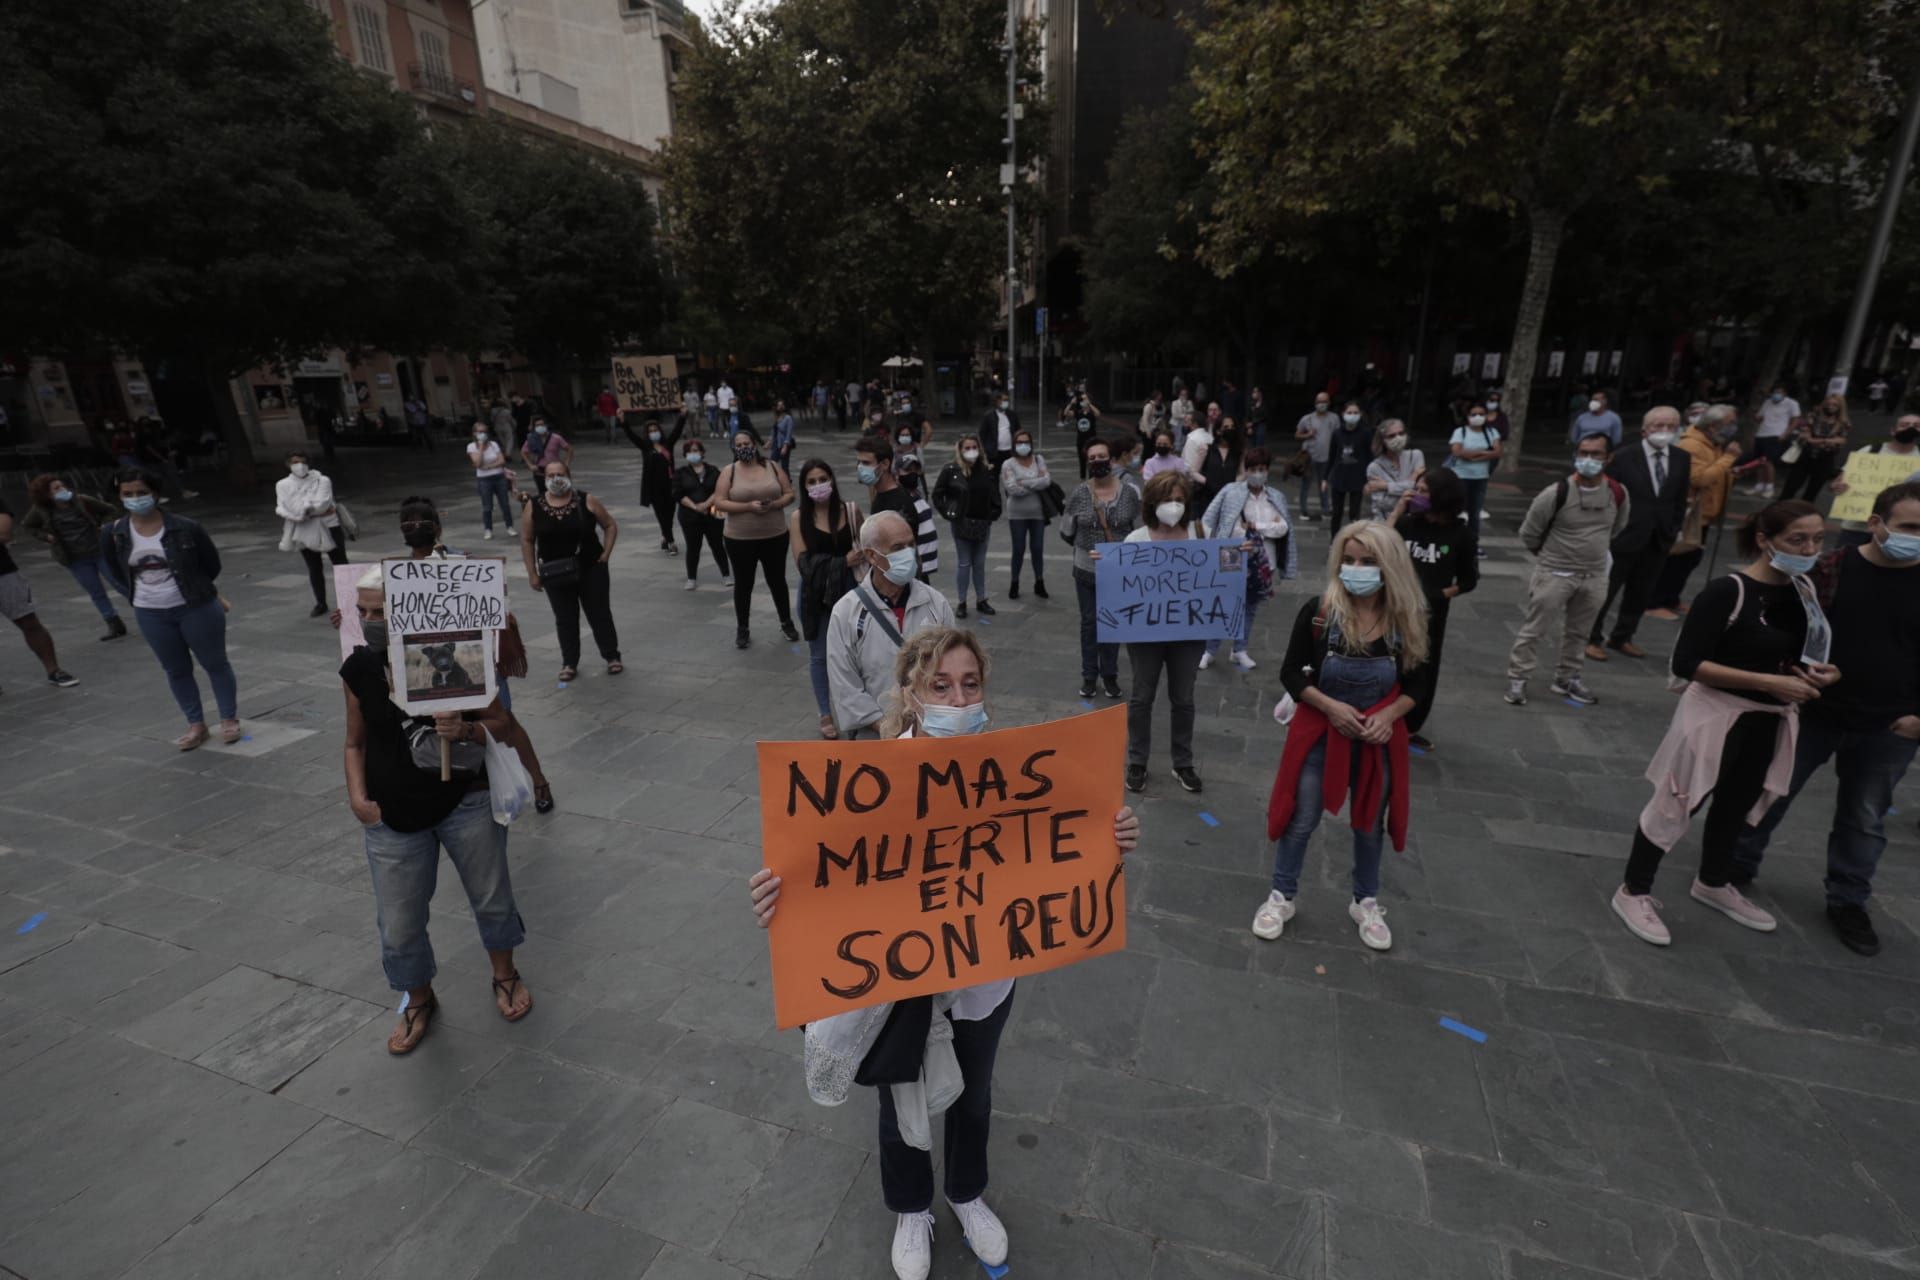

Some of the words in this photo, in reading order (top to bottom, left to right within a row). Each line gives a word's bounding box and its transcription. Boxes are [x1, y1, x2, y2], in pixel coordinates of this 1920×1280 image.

[644, 363, 662, 378] UN
[617, 379, 645, 395] SON
[1108, 543, 1208, 567] PEDRO
[390, 562, 496, 583] CARECEIS
[1122, 570, 1227, 597] MORELL
[437, 582, 462, 593] DE
[391, 591, 501, 616] HONESTIDAD
[390, 613, 502, 633] AYUNTAMIENTO
[787, 758, 891, 817] NO
[916, 749, 1056, 819] MAS
[814, 806, 1089, 888] MUERTE
[918, 872, 984, 913] EN
[821, 914, 980, 999] SON
[999, 861, 1124, 960] REUS
